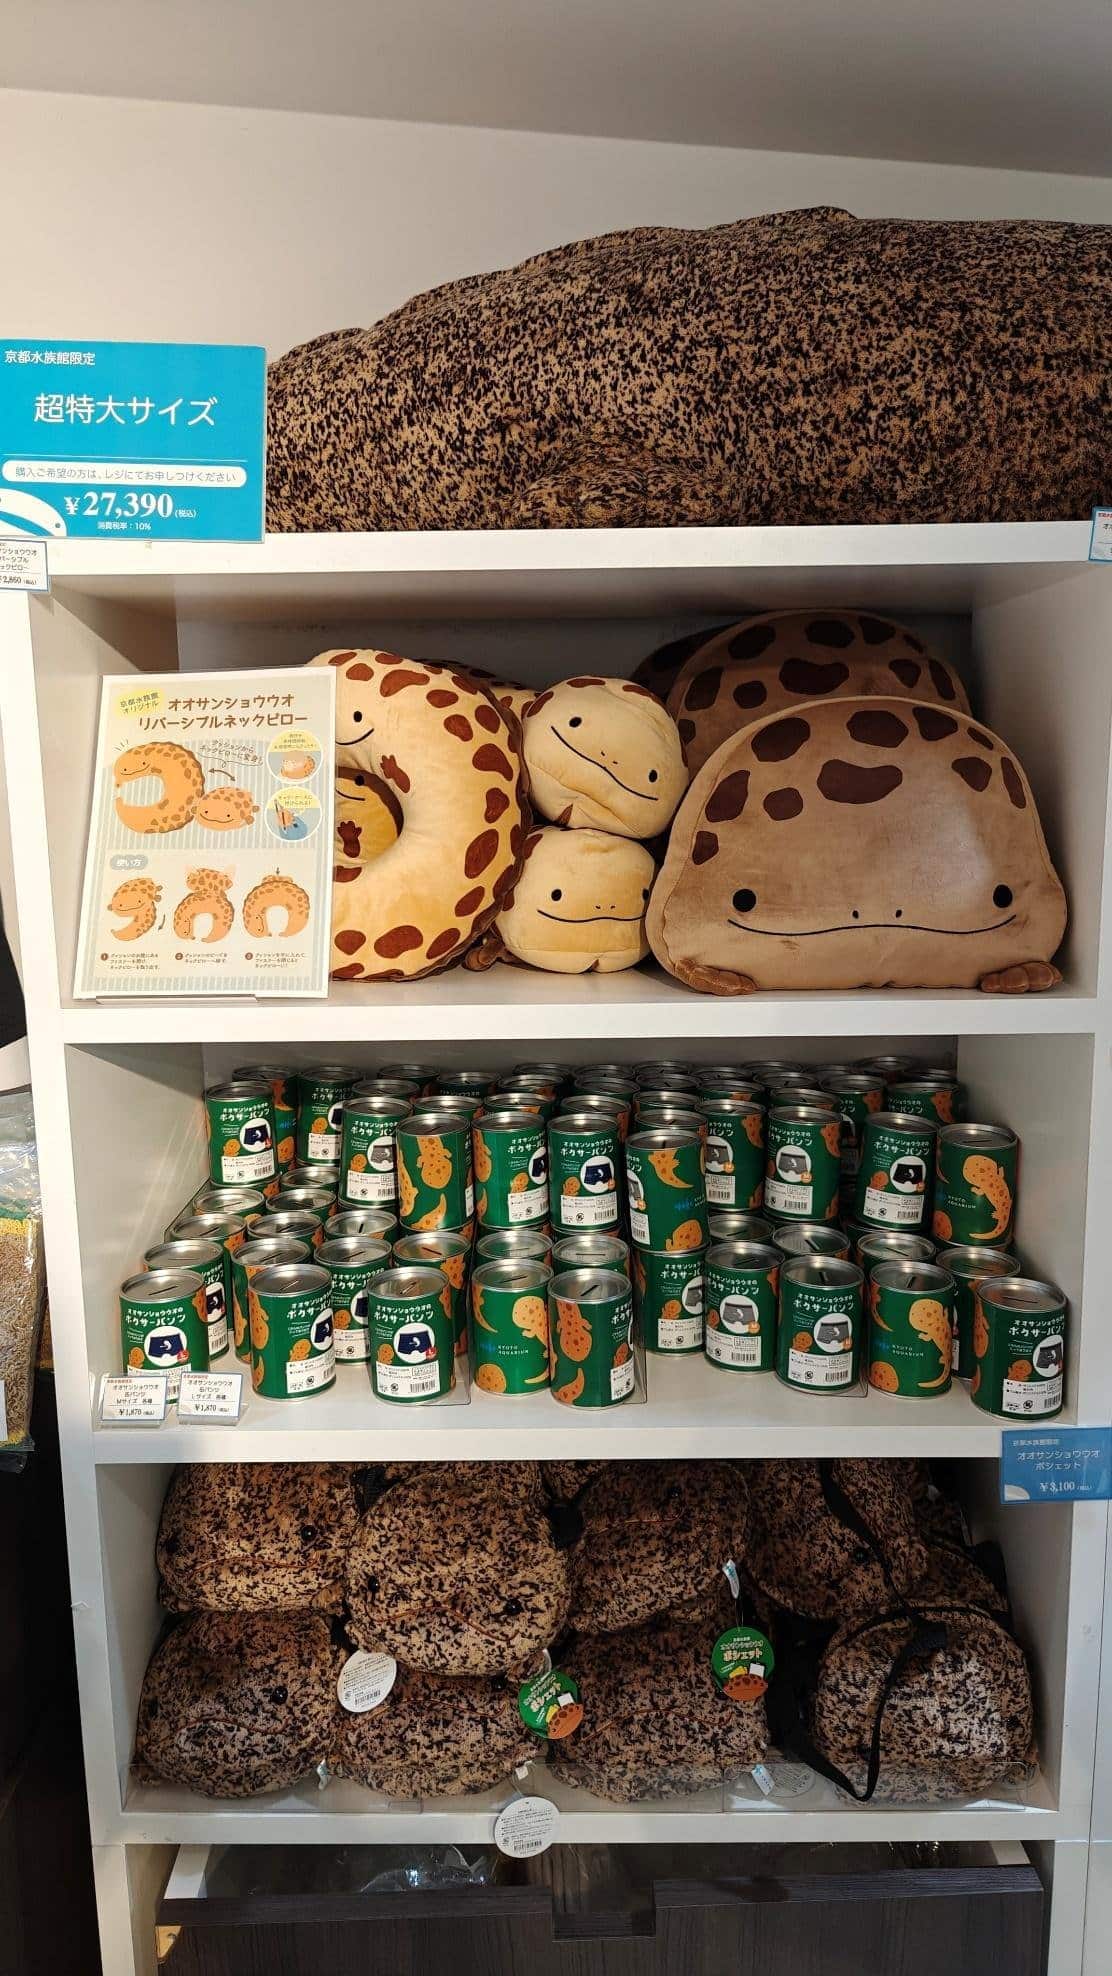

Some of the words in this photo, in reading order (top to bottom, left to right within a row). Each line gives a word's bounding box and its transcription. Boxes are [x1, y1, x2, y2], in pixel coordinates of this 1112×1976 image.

[5, 350, 95, 365] 京都水族館限定
[34, 392, 218, 425] 超特大サイズ
[15, 466, 236, 482] 購入ご希望の方は、レジにてお申しつけください
[64, 491, 174, 517] ¥27,390
[168, 694, 295, 712] オオサンショウウオ
[139, 714, 308, 731] リバーシブルネックピロー
[1017, 1450, 1100, 1461] オオサンショウウオ
